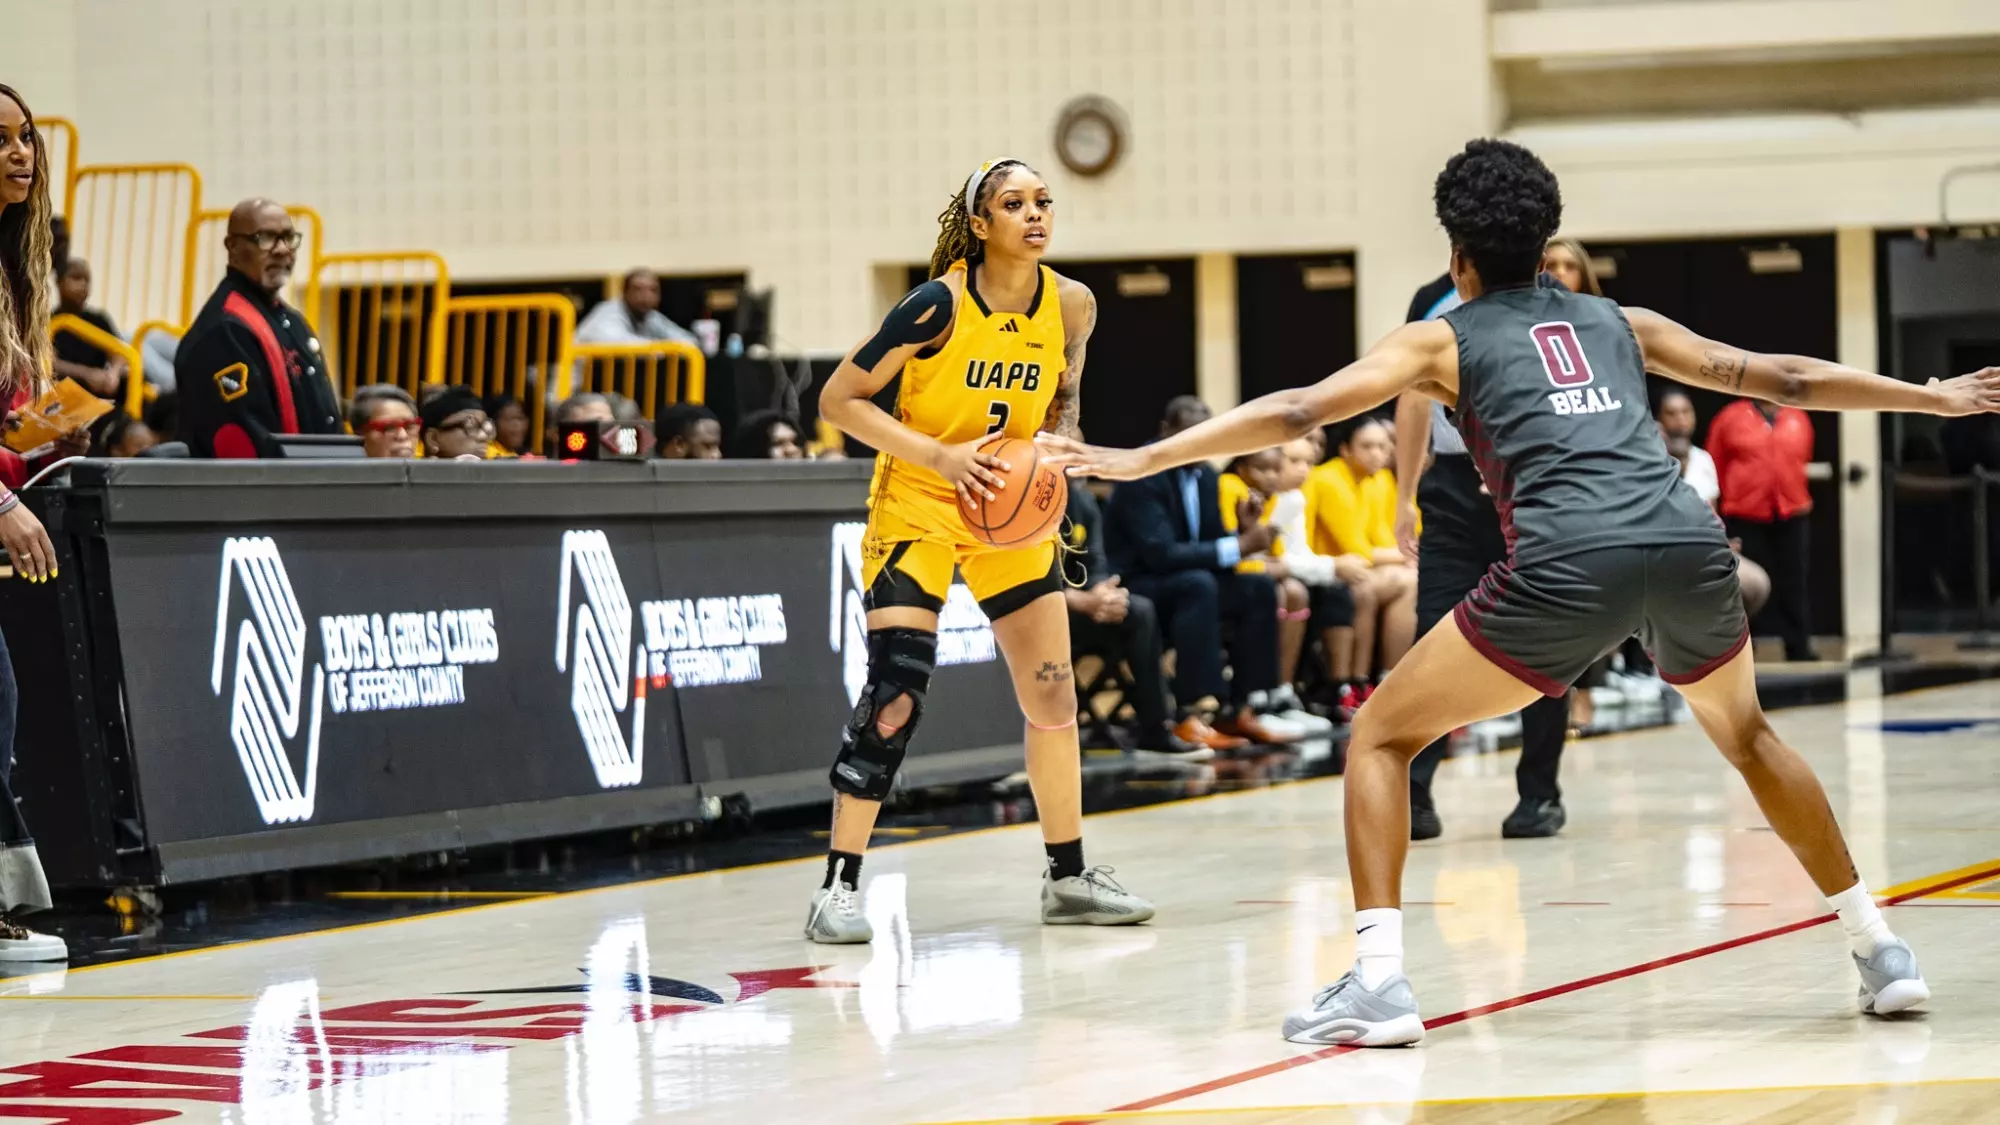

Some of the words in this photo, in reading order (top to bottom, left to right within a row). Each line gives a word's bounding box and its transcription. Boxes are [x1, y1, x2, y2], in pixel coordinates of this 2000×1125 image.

[965, 358, 1041, 392] UAPB
[1529, 321, 1594, 389] 0
[1548, 386, 1622, 415] BEAL
[319, 614, 374, 672] BOYS
[387, 610, 443, 667] GIRLS
[440, 608, 499, 664] CLUBS
[328, 671, 348, 714] OF
[350, 667, 420, 712] JEFFERSON
[417, 664, 465, 707] COUNTY
